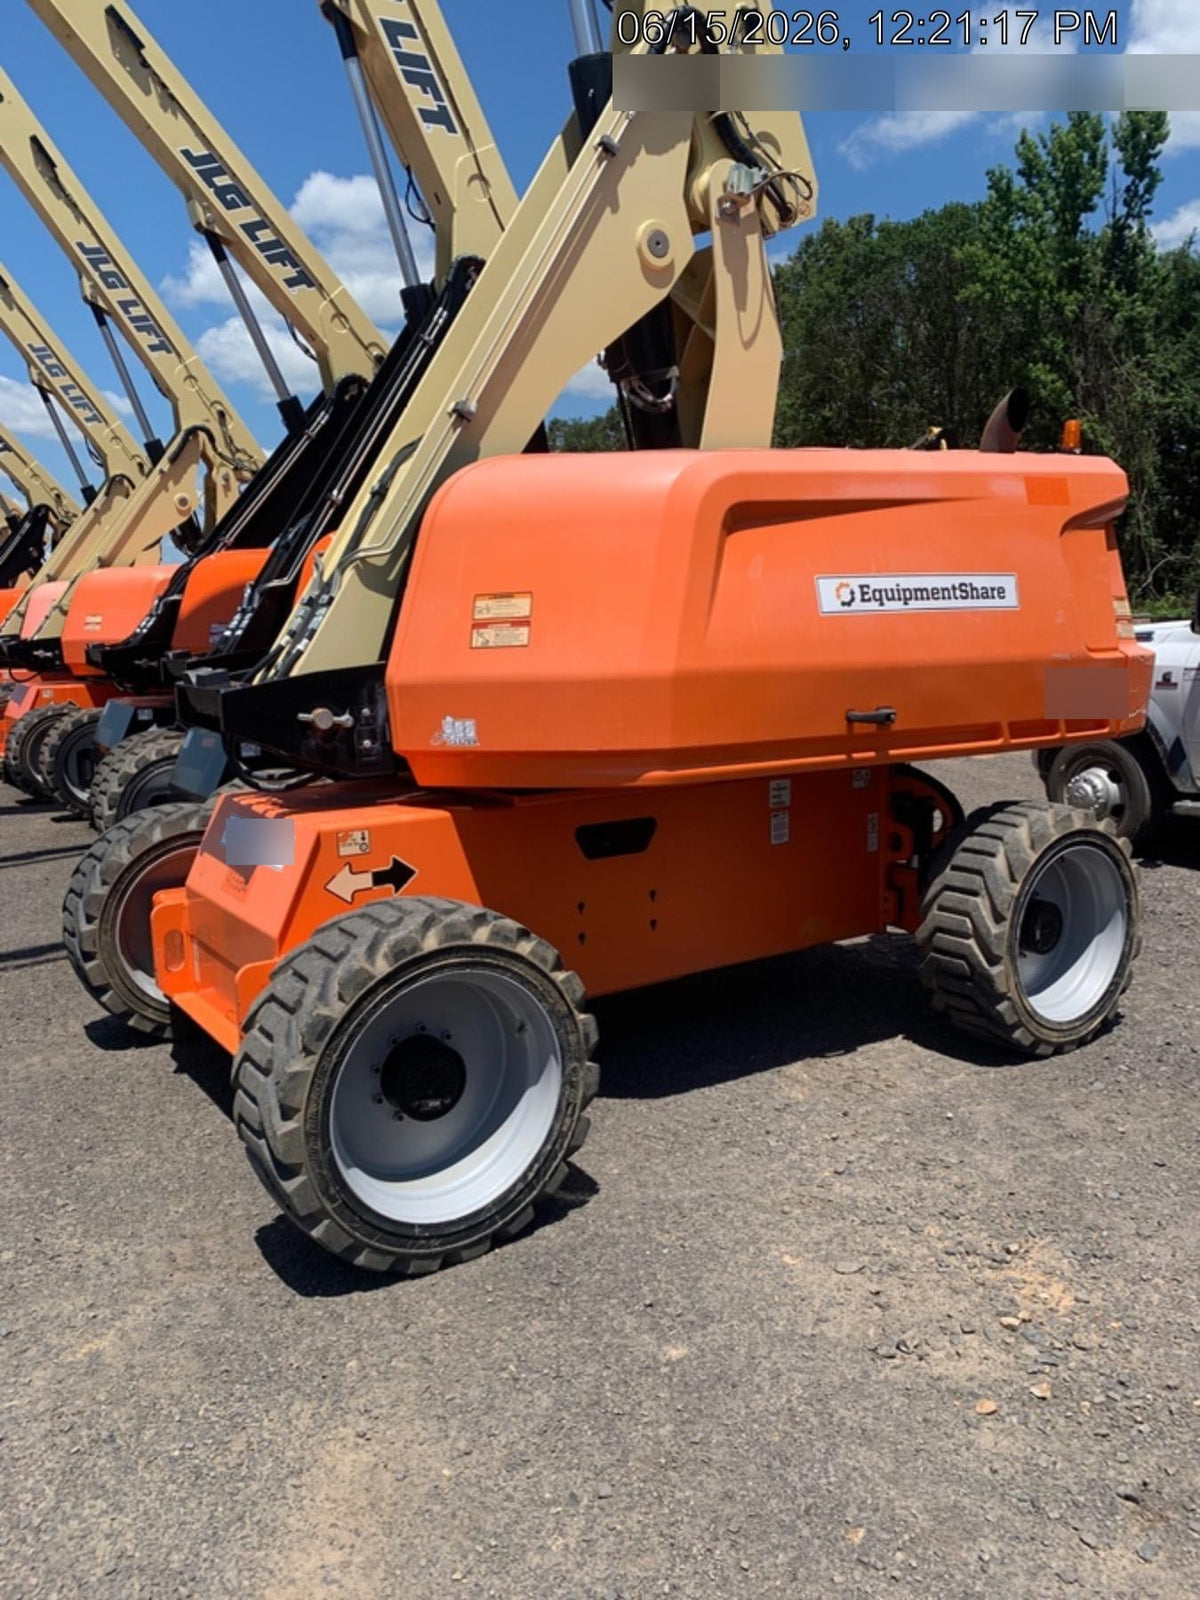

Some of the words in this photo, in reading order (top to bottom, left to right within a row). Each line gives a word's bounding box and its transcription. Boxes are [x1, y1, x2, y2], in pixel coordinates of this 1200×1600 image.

[379, 17, 459, 134] LIFT
[179, 148, 251, 211] JLG
[239, 218, 315, 289] LIFT
[75, 241, 129, 290] JLG
[117, 299, 173, 354] LIFT
[27, 343, 66, 378] JLG
[59, 384, 103, 423] LIFT
[858, 582, 1007, 606] EquipmentShare
